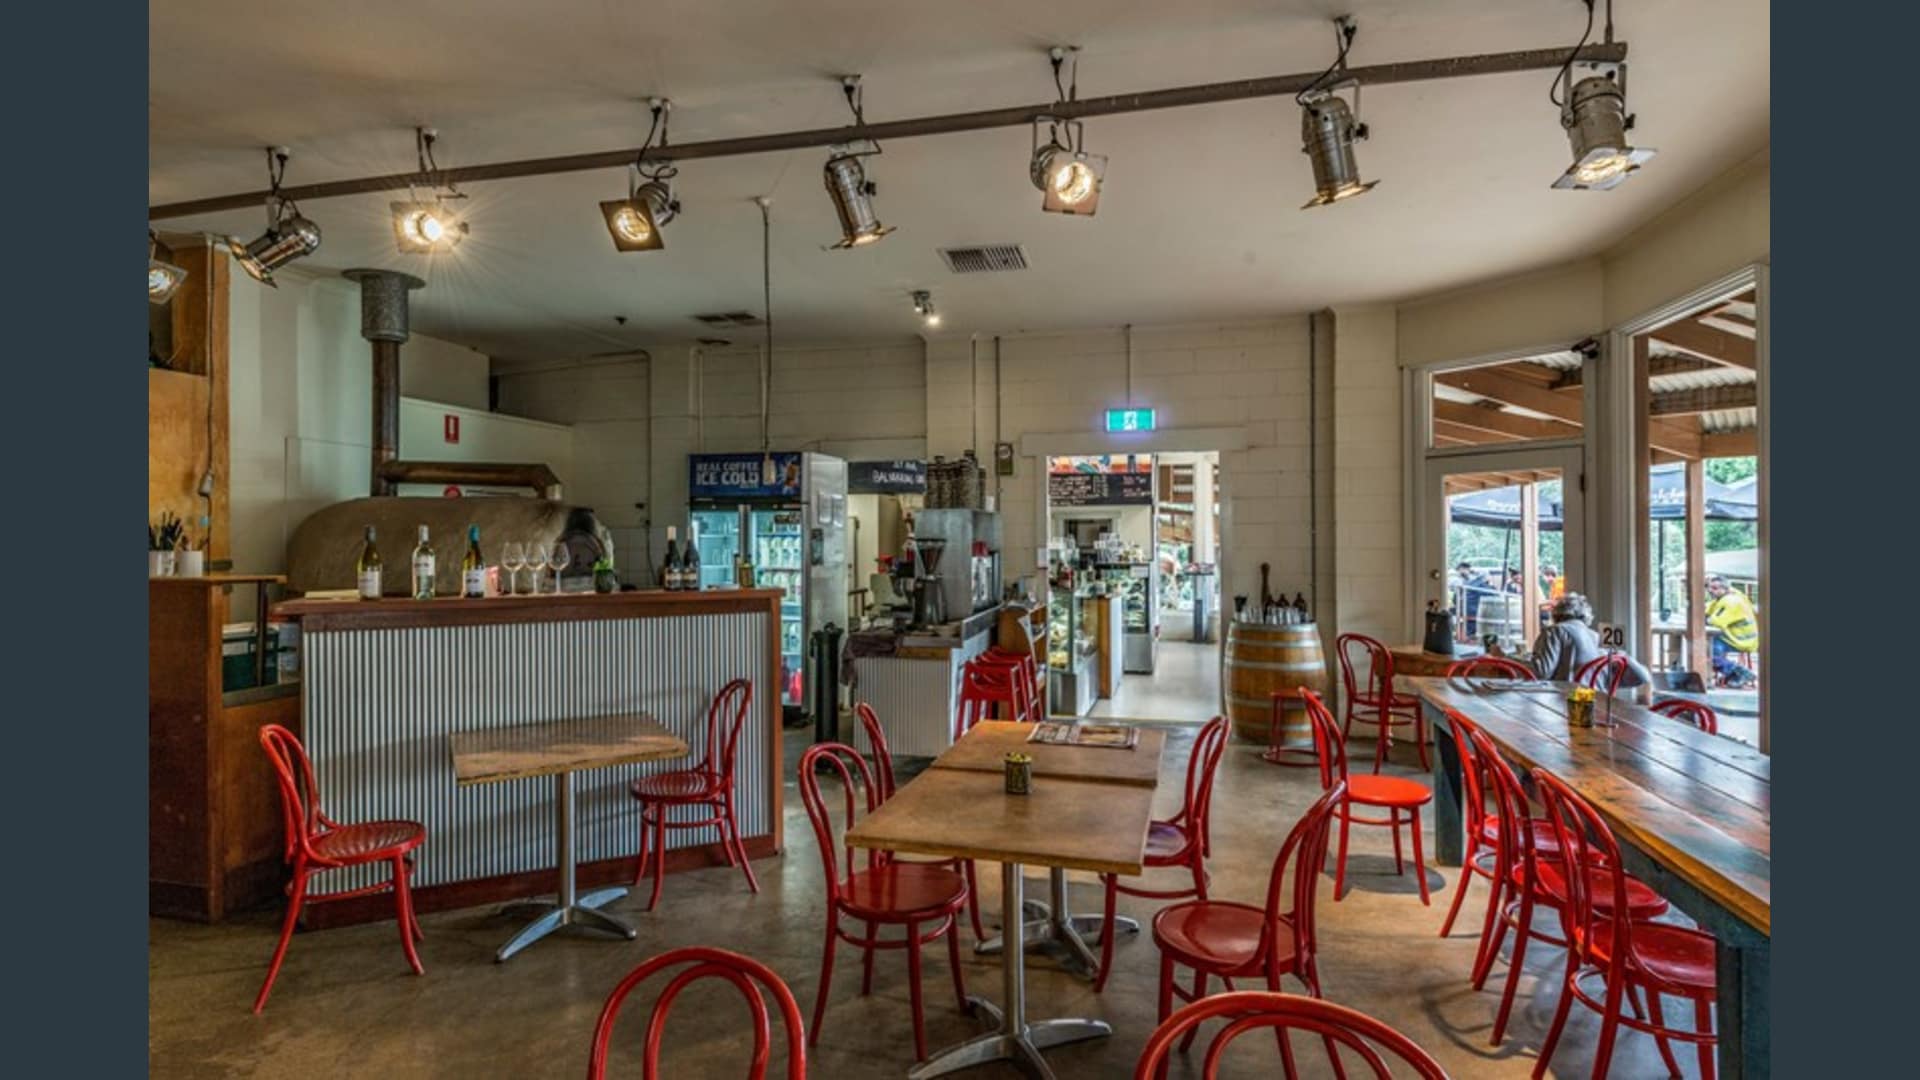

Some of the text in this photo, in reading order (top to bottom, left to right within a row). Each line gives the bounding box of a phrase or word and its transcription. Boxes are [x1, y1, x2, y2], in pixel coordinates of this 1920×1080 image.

[696, 462, 760, 472] REAL COFFEE
[696, 472, 760, 486] ICE COLD
[1603, 626, 1623, 647] 20
